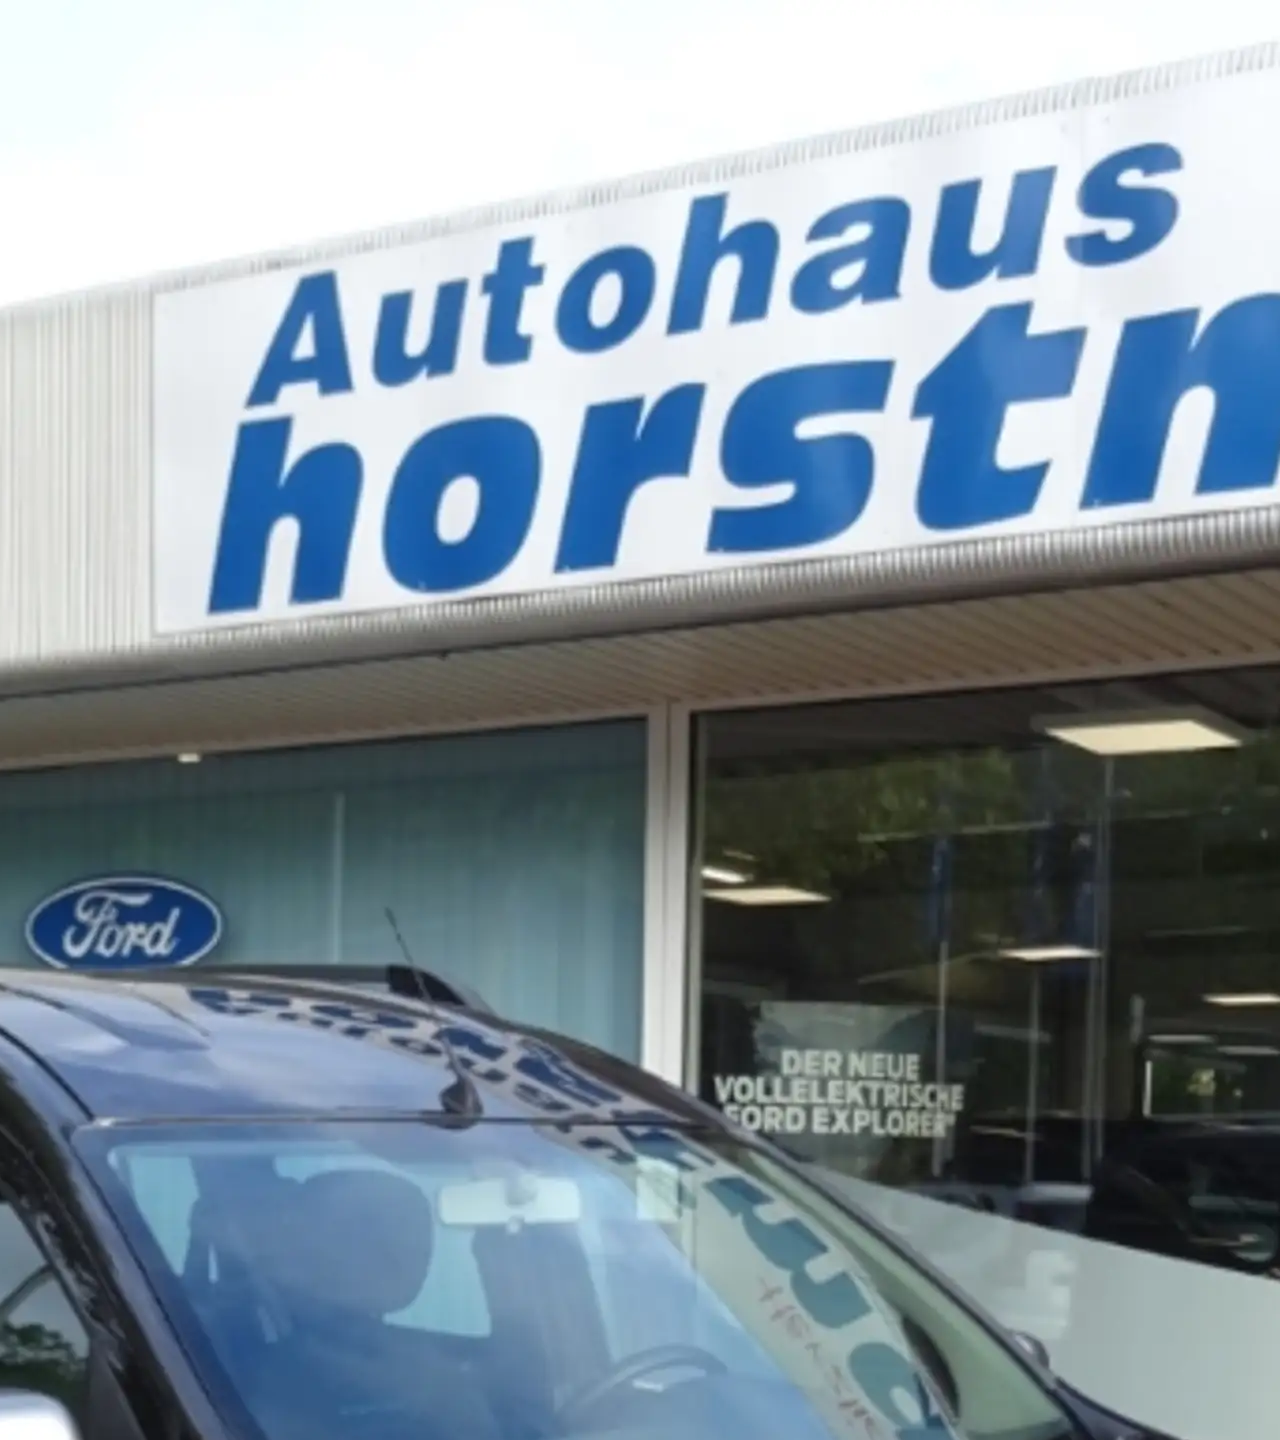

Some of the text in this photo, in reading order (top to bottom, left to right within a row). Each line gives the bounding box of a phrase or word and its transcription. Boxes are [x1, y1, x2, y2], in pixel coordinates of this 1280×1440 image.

[247, 142, 1183, 409] Autohaus
[62, 889, 180, 958] Ford
[780, 1049, 920, 1081] DER NEUE
[713, 1074, 965, 1111] VOLLELEKTRISCHE
[723, 1104, 807, 1134] FORD
